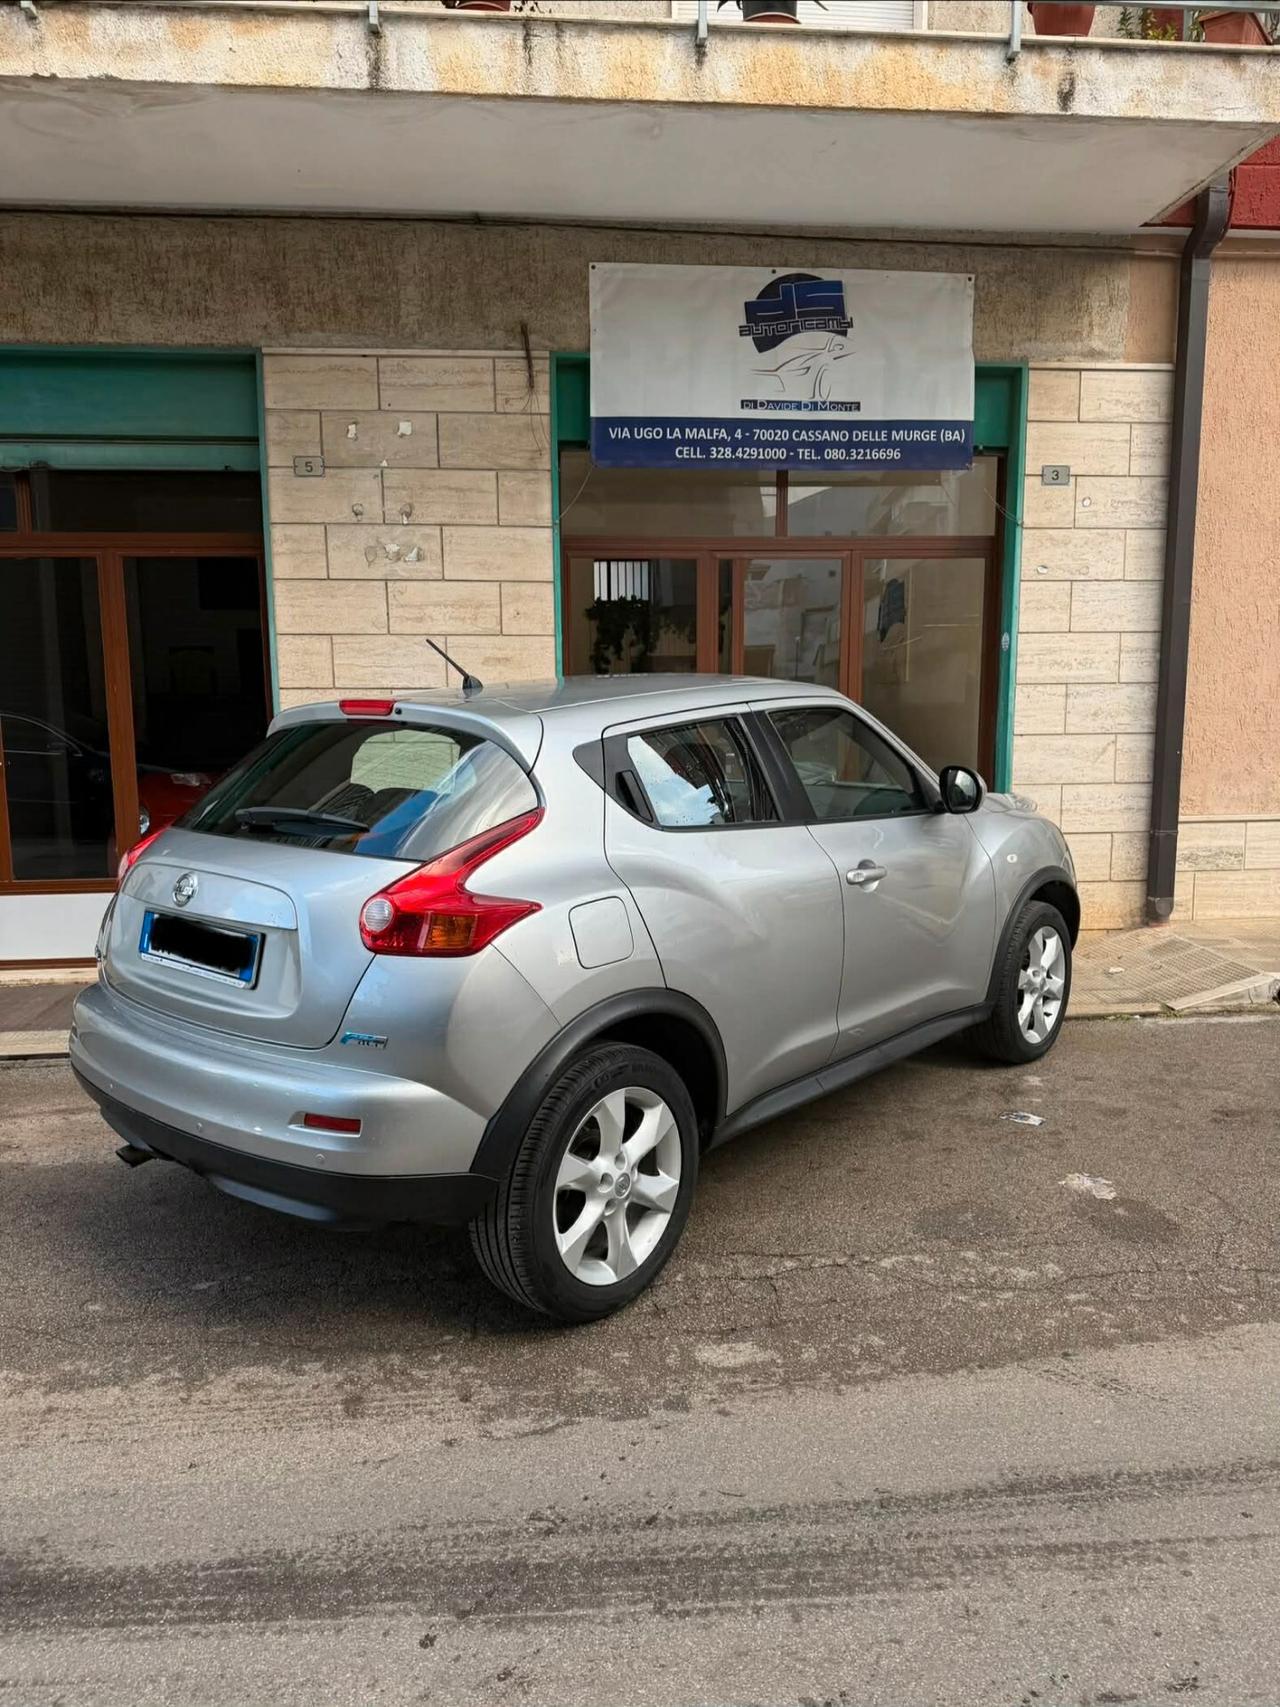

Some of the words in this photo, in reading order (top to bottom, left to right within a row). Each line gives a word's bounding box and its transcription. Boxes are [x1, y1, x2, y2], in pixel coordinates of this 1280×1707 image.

[608, 427, 631, 440] VIA
[634, 427, 663, 440] UGO
[666, 427, 684, 440] LA
[685, 428, 731, 442] MALFA,
[734, 428, 742, 440] 4
[753, 428, 789, 441] 70020
[792, 429, 849, 442] CASSANO
[852, 430, 888, 442] DELLE
[891, 430, 937, 442] MURGE
[940, 429, 966, 443] (BA)
[675, 446, 706, 459] CELL.
[709, 446, 787, 459] 328.4291000
[797, 448, 821, 460] TEL.
[824, 448, 901, 460] 080.3216696
[305, 461, 313, 472] 5
[1051, 469, 1060, 481] 3
